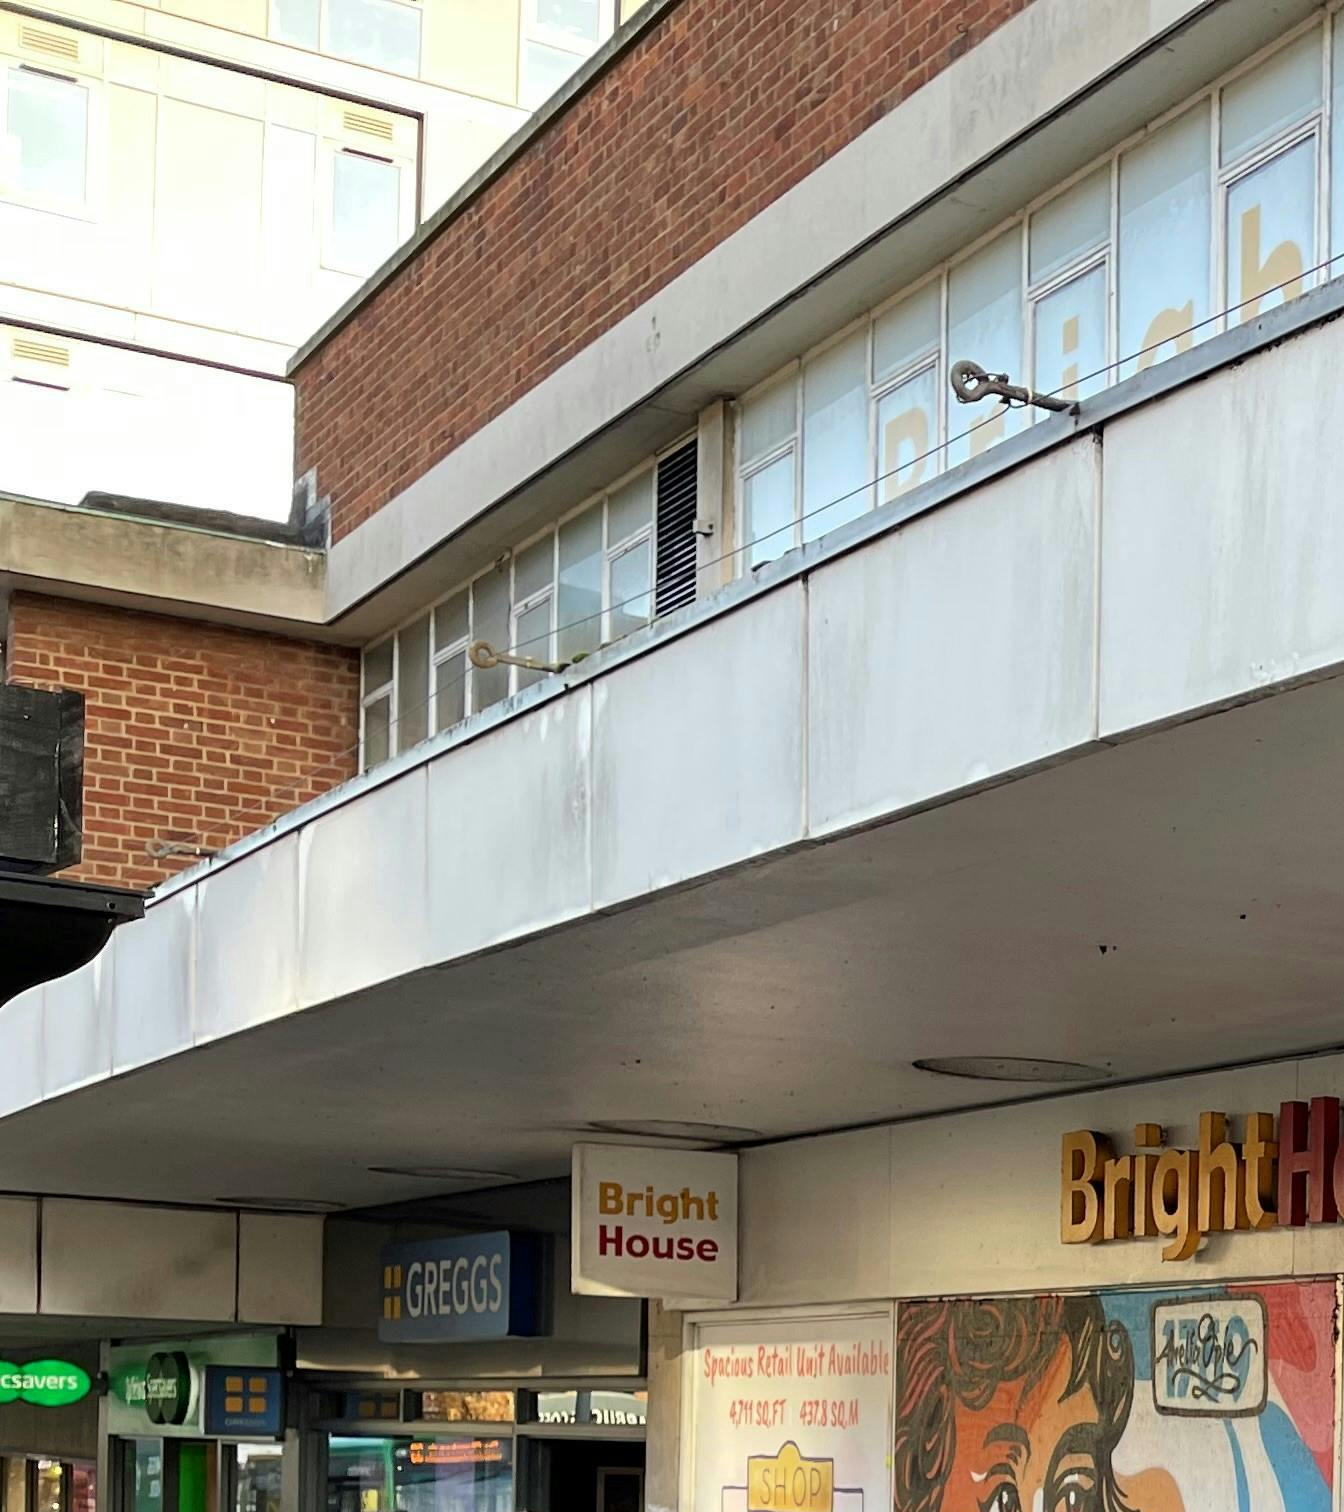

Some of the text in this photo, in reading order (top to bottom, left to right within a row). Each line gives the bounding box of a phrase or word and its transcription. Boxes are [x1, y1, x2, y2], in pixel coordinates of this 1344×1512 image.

[598, 1182, 719, 1224] Bright
[598, 1225, 719, 1261] House
[406, 1253, 502, 1318] GREGGS
[704, 1339, 889, 1387] Spacious Retail Unit Available
[800, 1400, 828, 1426] 437.8
[759, 1466, 822, 1507] SHOP
